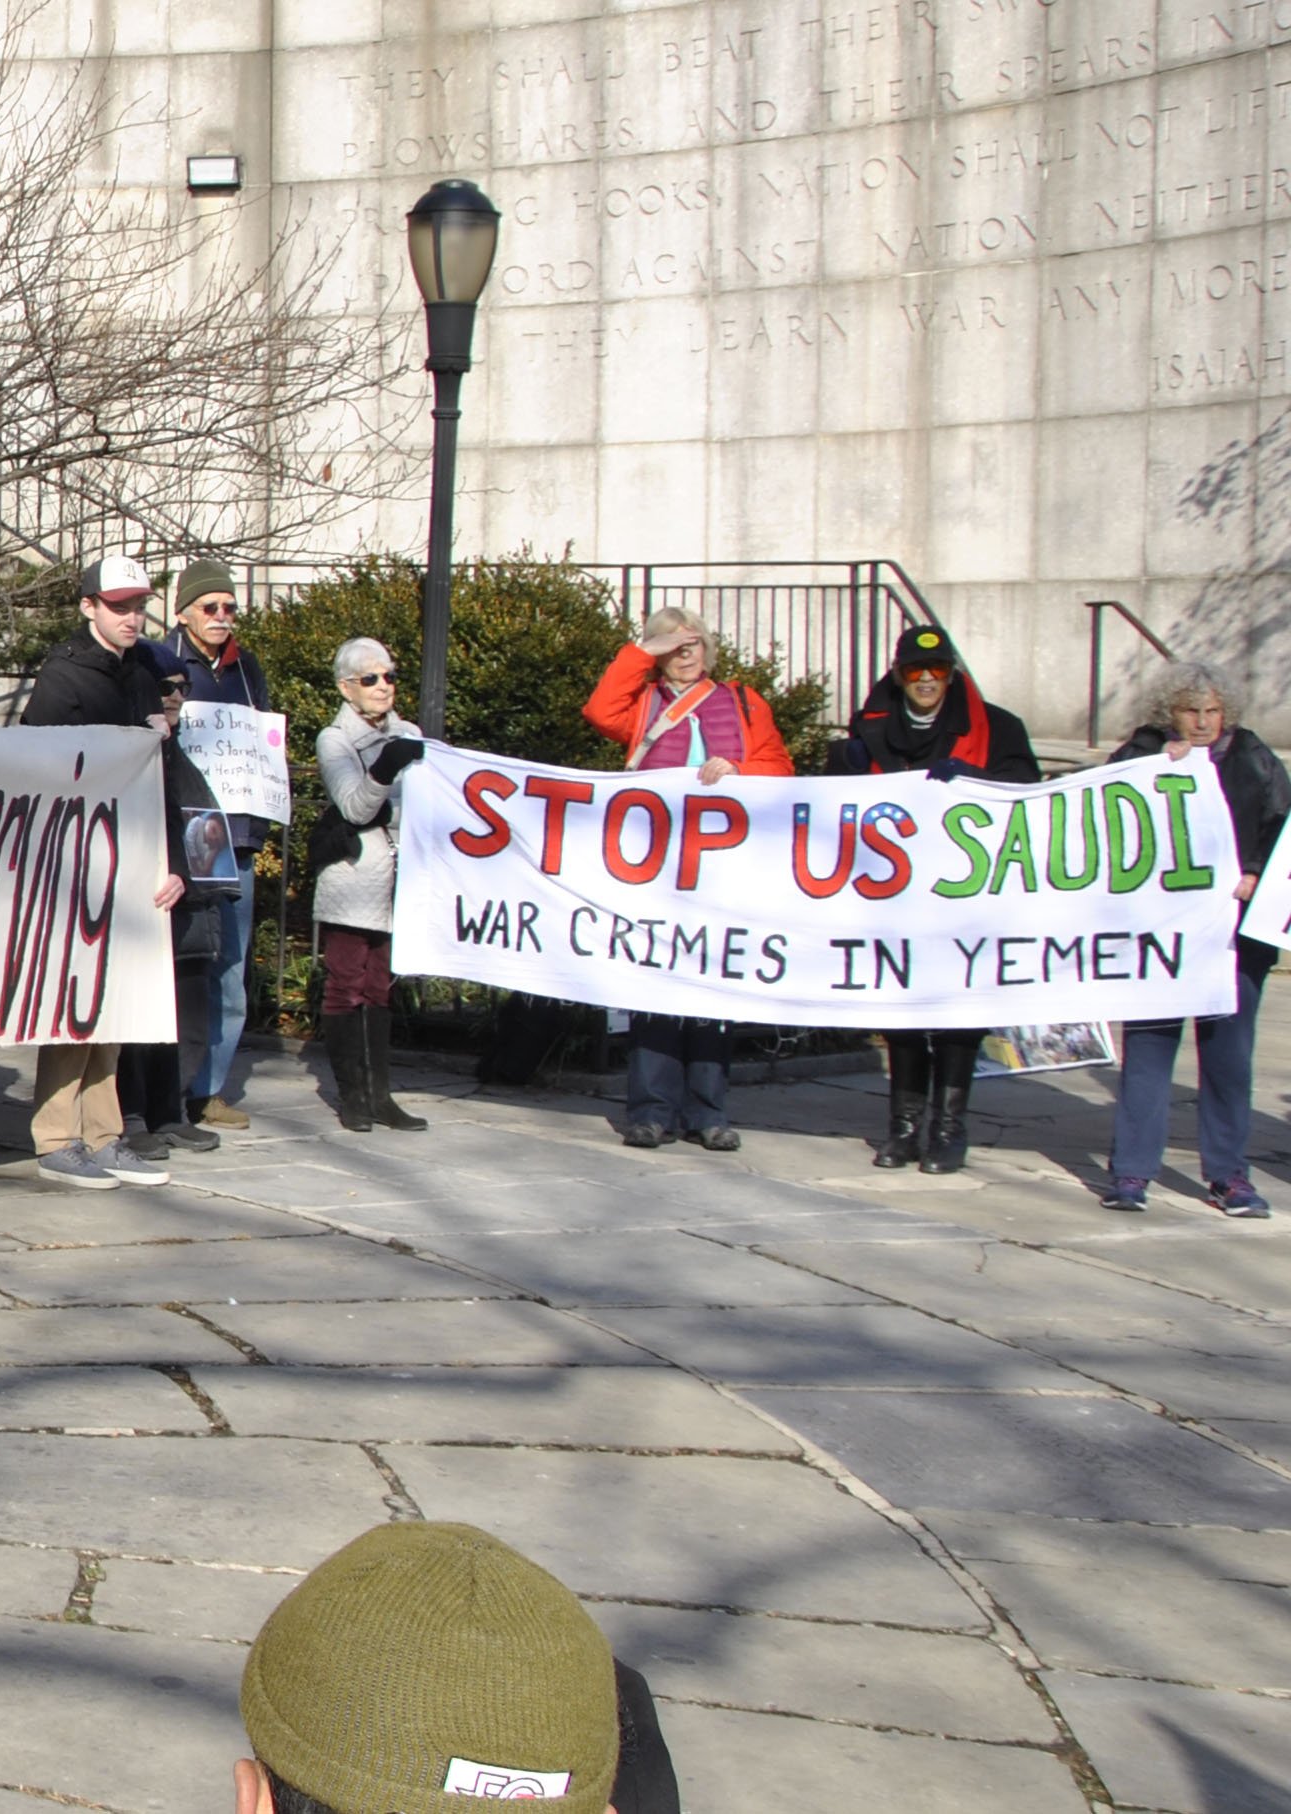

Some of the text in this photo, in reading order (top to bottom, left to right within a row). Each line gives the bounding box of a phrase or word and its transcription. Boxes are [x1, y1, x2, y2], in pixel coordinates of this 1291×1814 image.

[339, 66, 456, 103] THEY
[492, 50, 627, 91] SHALL
[662, 28, 764, 74] BEAT
[799, 0, 940, 52] THEIR
[687, 99, 778, 140] AND
[820, 70, 964, 124] THEIR
[997, 29, 1153, 95] SPEARS
[757, 153, 921, 212] NATION
[950, 128, 1078, 180] SHALL
[1095, 104, 1181, 158] NOT
[499, 259, 595, 297] ORD
[619, 237, 819, 288] AGAINST
[1093, 166, 1291, 237] NEITHER
[521, 323, 643, 366] THEY
[687, 308, 852, 355] LEARN
[898, 296, 1008, 335] WAR
[1046, 276, 1135, 324] ANY
[1168, 254, 1291, 310] MORE
[1150, 338, 1290, 393] ISAIAH
[449, 769, 1215, 901] STOP US SAUDI
[455, 894, 1185, 992] WAR CRIMES IN YEMEN
